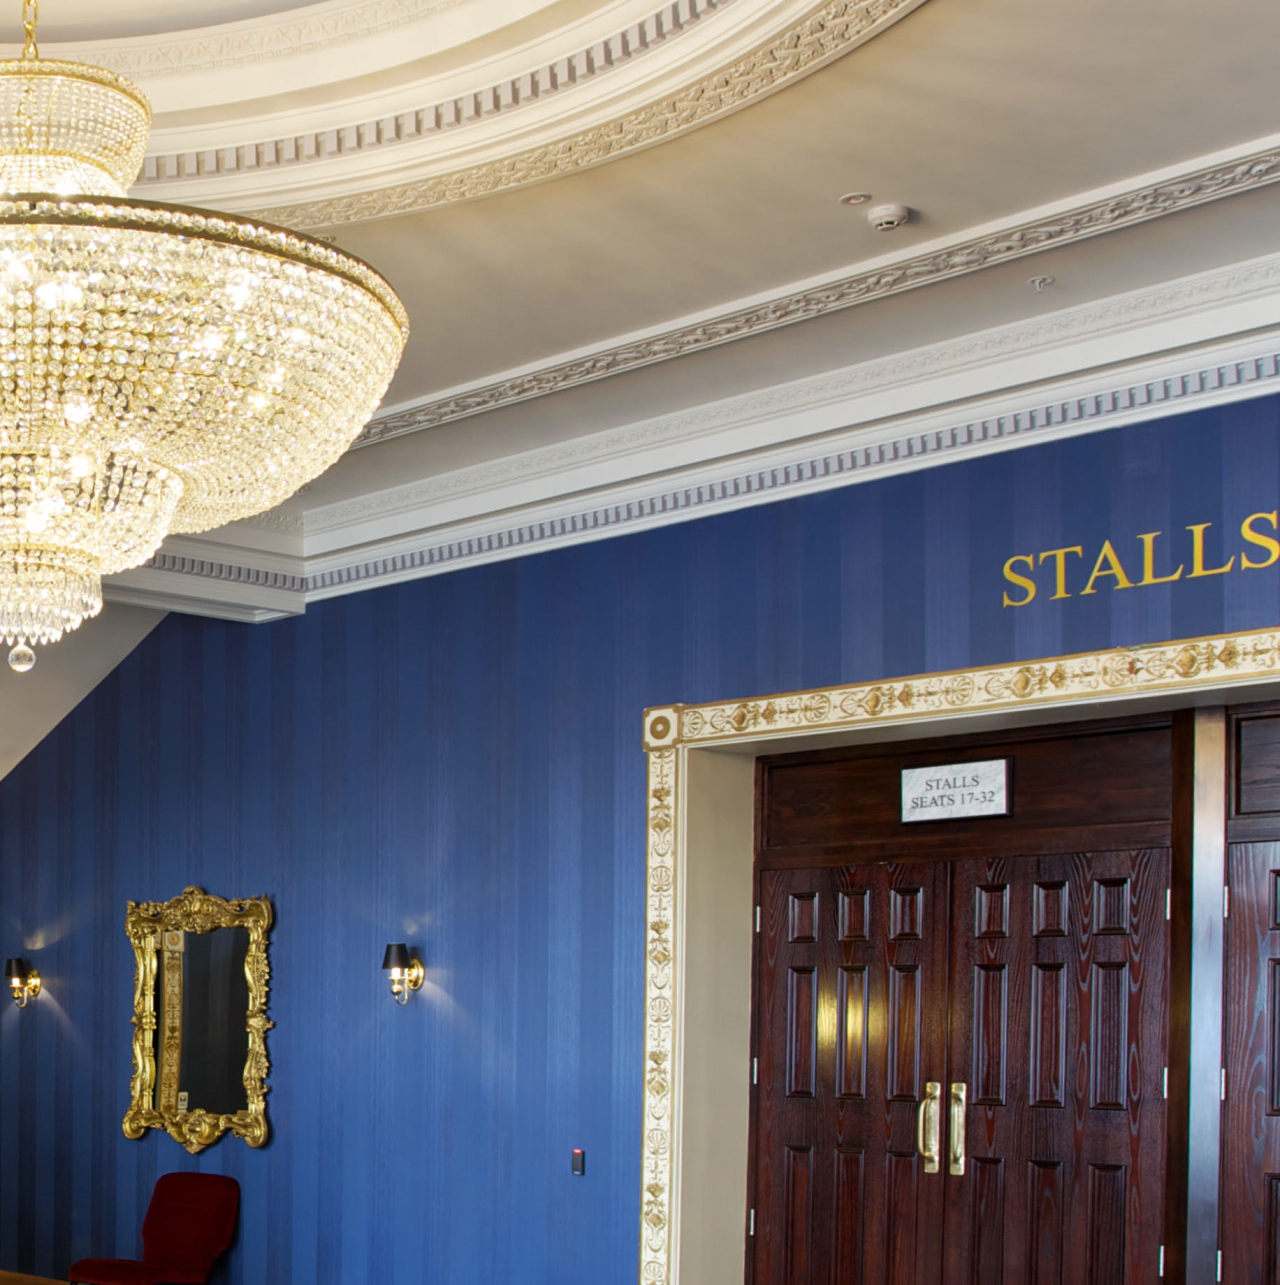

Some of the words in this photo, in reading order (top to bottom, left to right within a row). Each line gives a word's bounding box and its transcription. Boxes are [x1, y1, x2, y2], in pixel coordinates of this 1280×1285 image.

[1002, 509, 1280, 609] STALLS
[924, 775, 981, 792] STALLS
[910, 794, 956, 810] SEATS
[960, 790, 996, 806] 17-32
